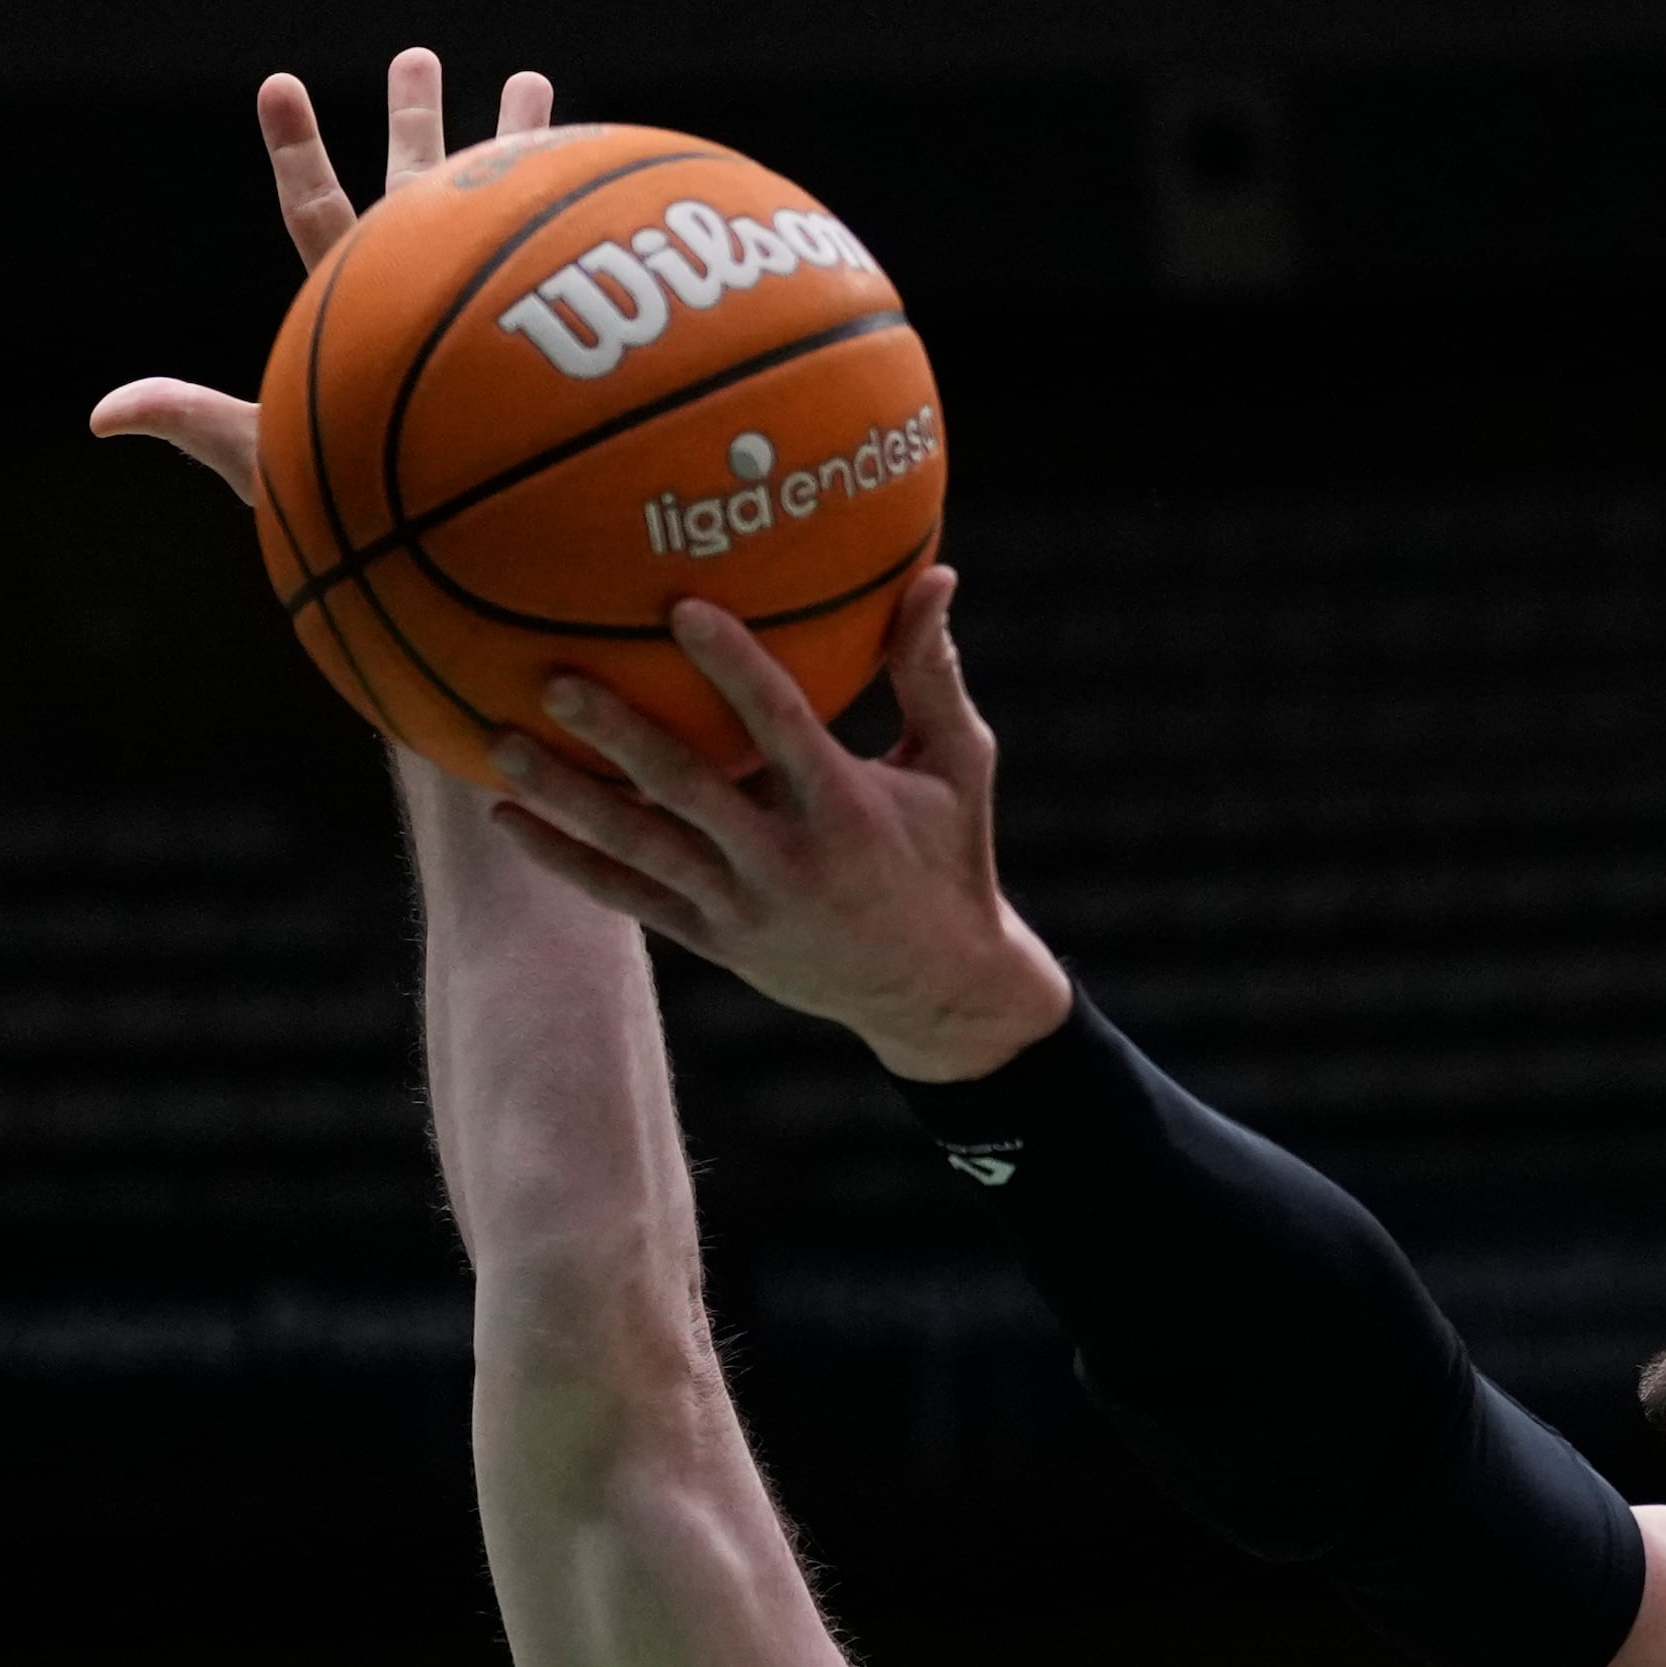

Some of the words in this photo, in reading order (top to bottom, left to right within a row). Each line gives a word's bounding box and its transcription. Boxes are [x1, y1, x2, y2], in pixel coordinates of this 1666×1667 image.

[499, 200, 880, 380] Wilson
[644, 484, 774, 559] liga
[780, 403, 938, 519] endesa
